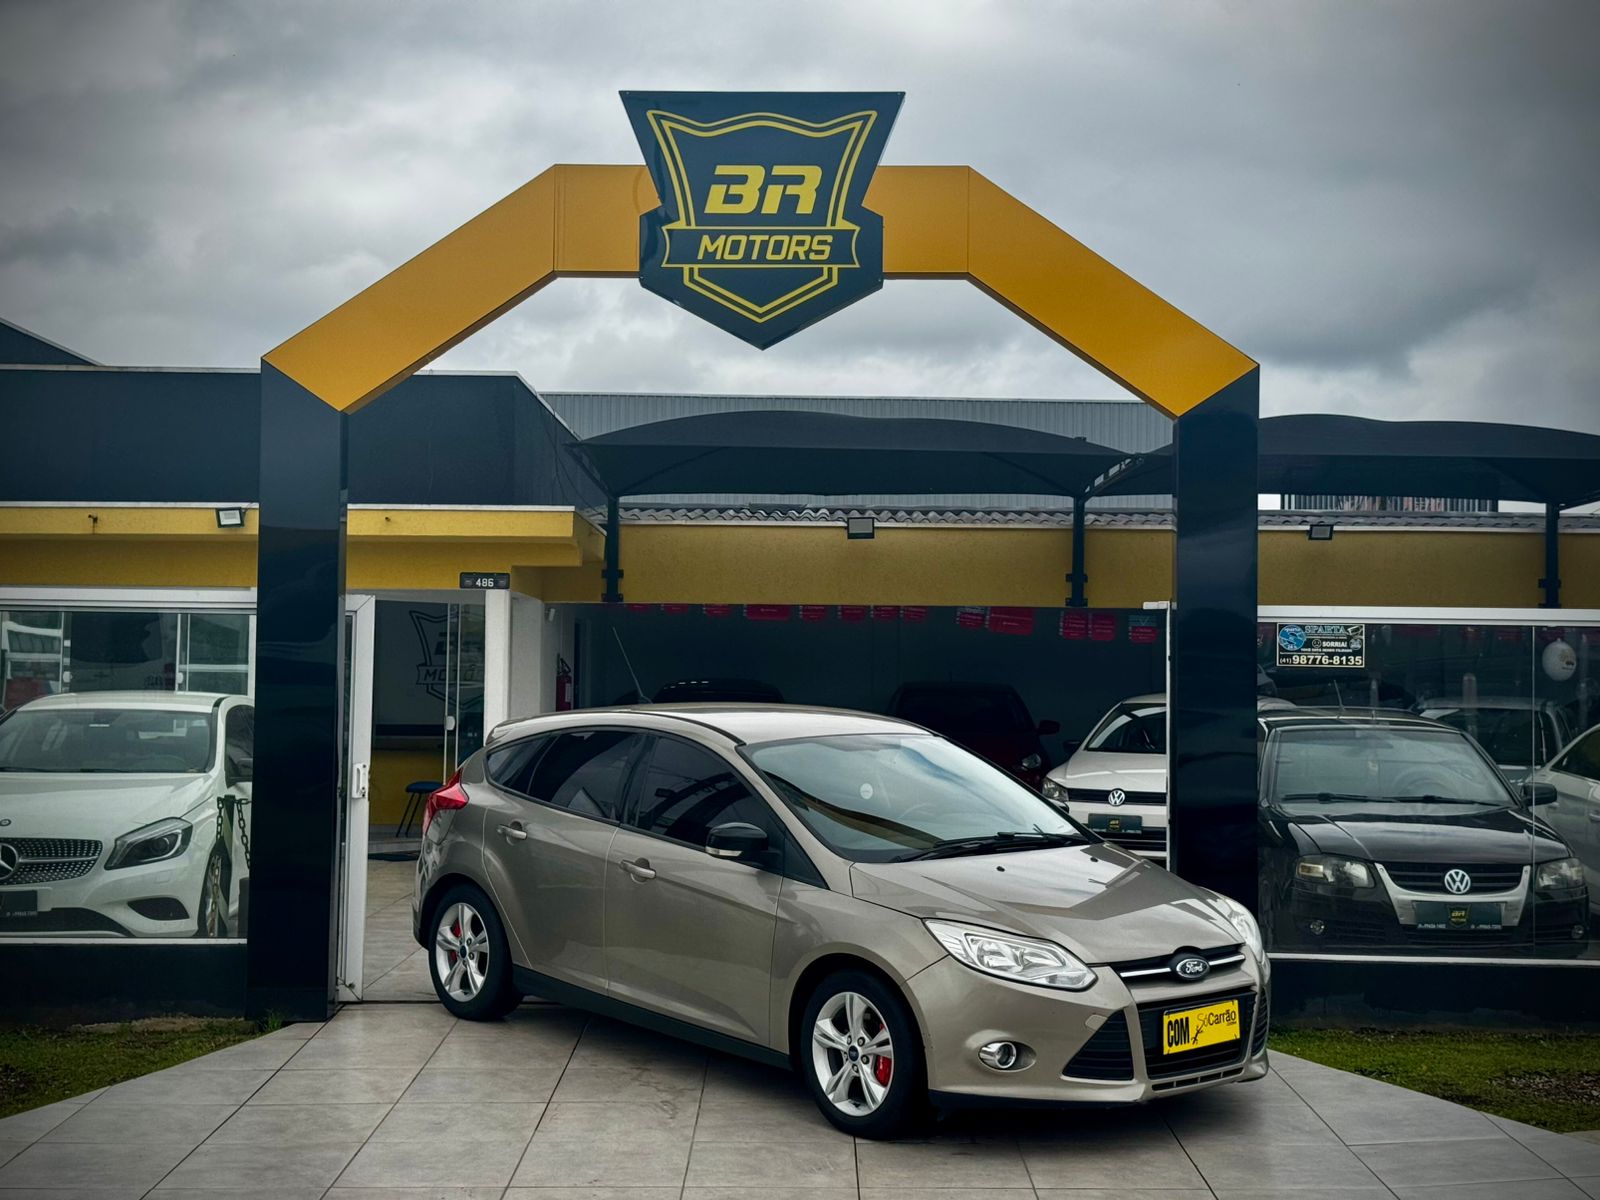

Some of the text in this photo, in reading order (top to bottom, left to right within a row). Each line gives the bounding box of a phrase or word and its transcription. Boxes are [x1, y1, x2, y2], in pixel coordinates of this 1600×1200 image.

[704, 165, 822, 214] BR
[697, 234, 833, 260] MOTORS
[476, 577, 494, 588] 486
[1304, 625, 1346, 634] SPARTA
[1292, 655, 1362, 665] 98776-8135
[1185, 961, 1203, 974] Ford
[1167, 1016, 1190, 1048] COM
